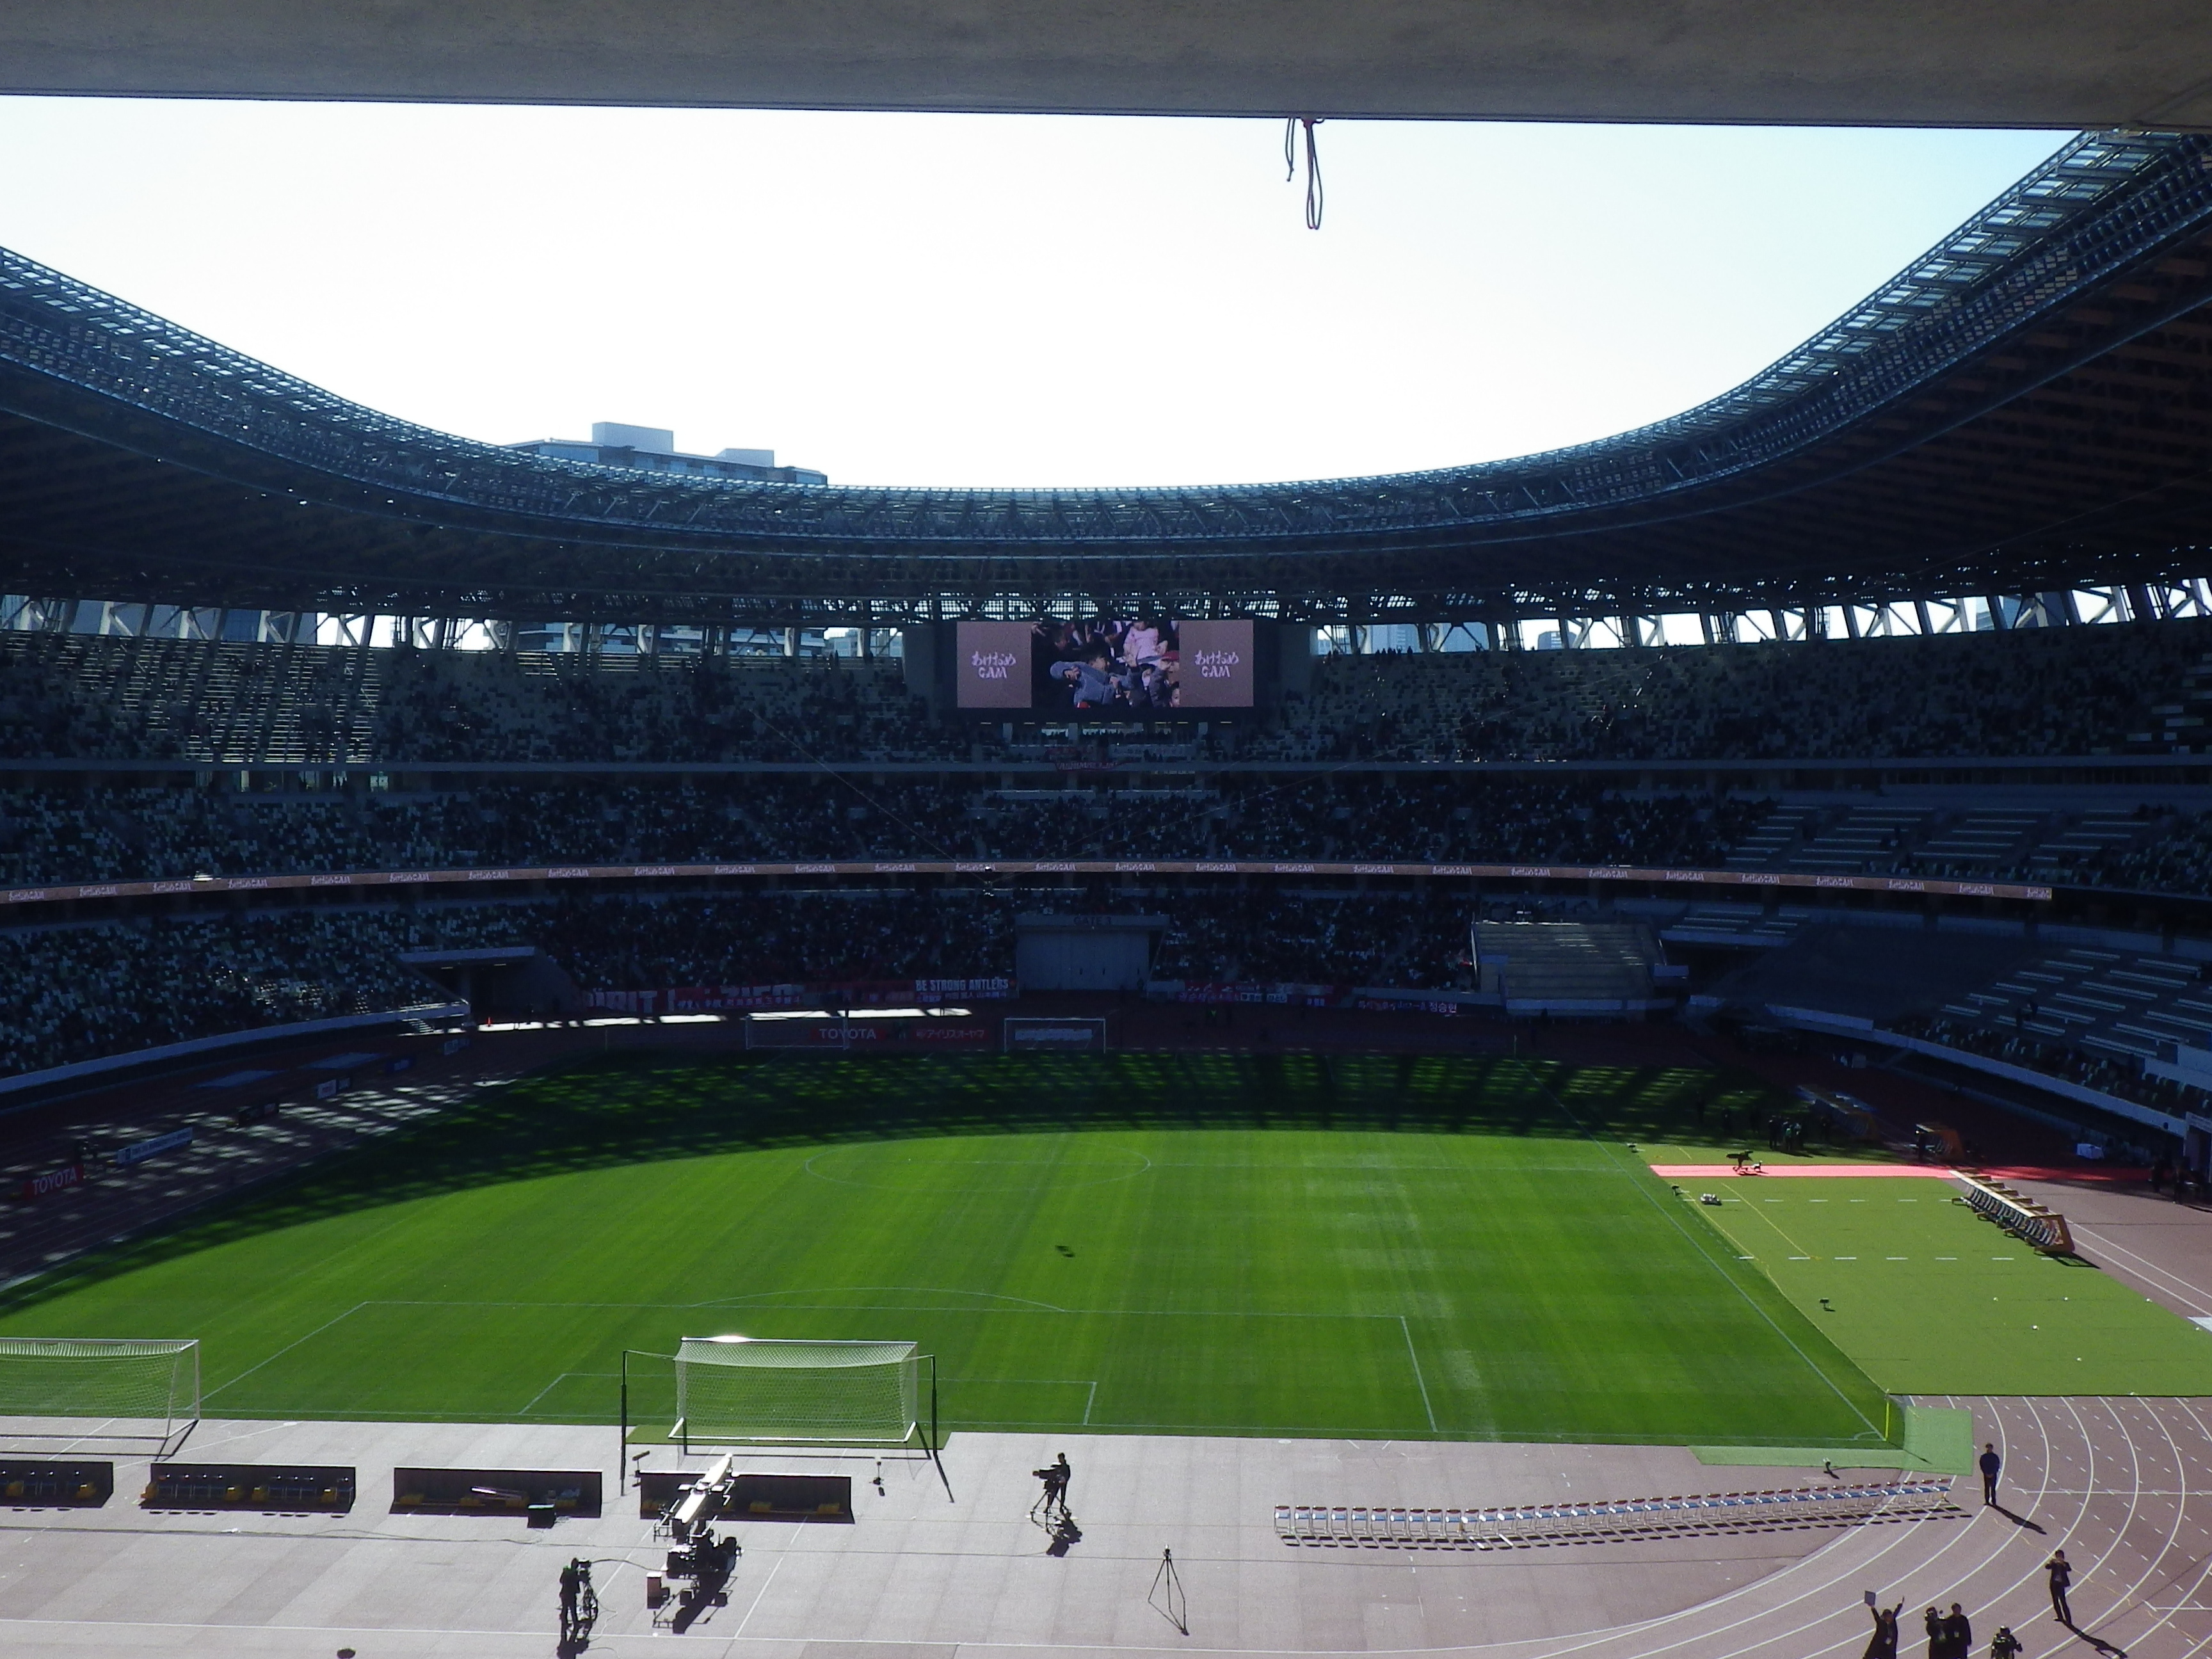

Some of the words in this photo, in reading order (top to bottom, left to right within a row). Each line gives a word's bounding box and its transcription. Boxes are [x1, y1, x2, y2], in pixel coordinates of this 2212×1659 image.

[979, 667, 1007, 678] CAM
[1201, 666, 1230, 677] CAM
[915, 979, 927, 991] BE
[930, 979, 966, 991] STRONG
[968, 977, 1009, 991] ANTLERS
[819, 1029, 877, 1040] TOYOTA
[31, 1167, 77, 1196] TOYOTA
